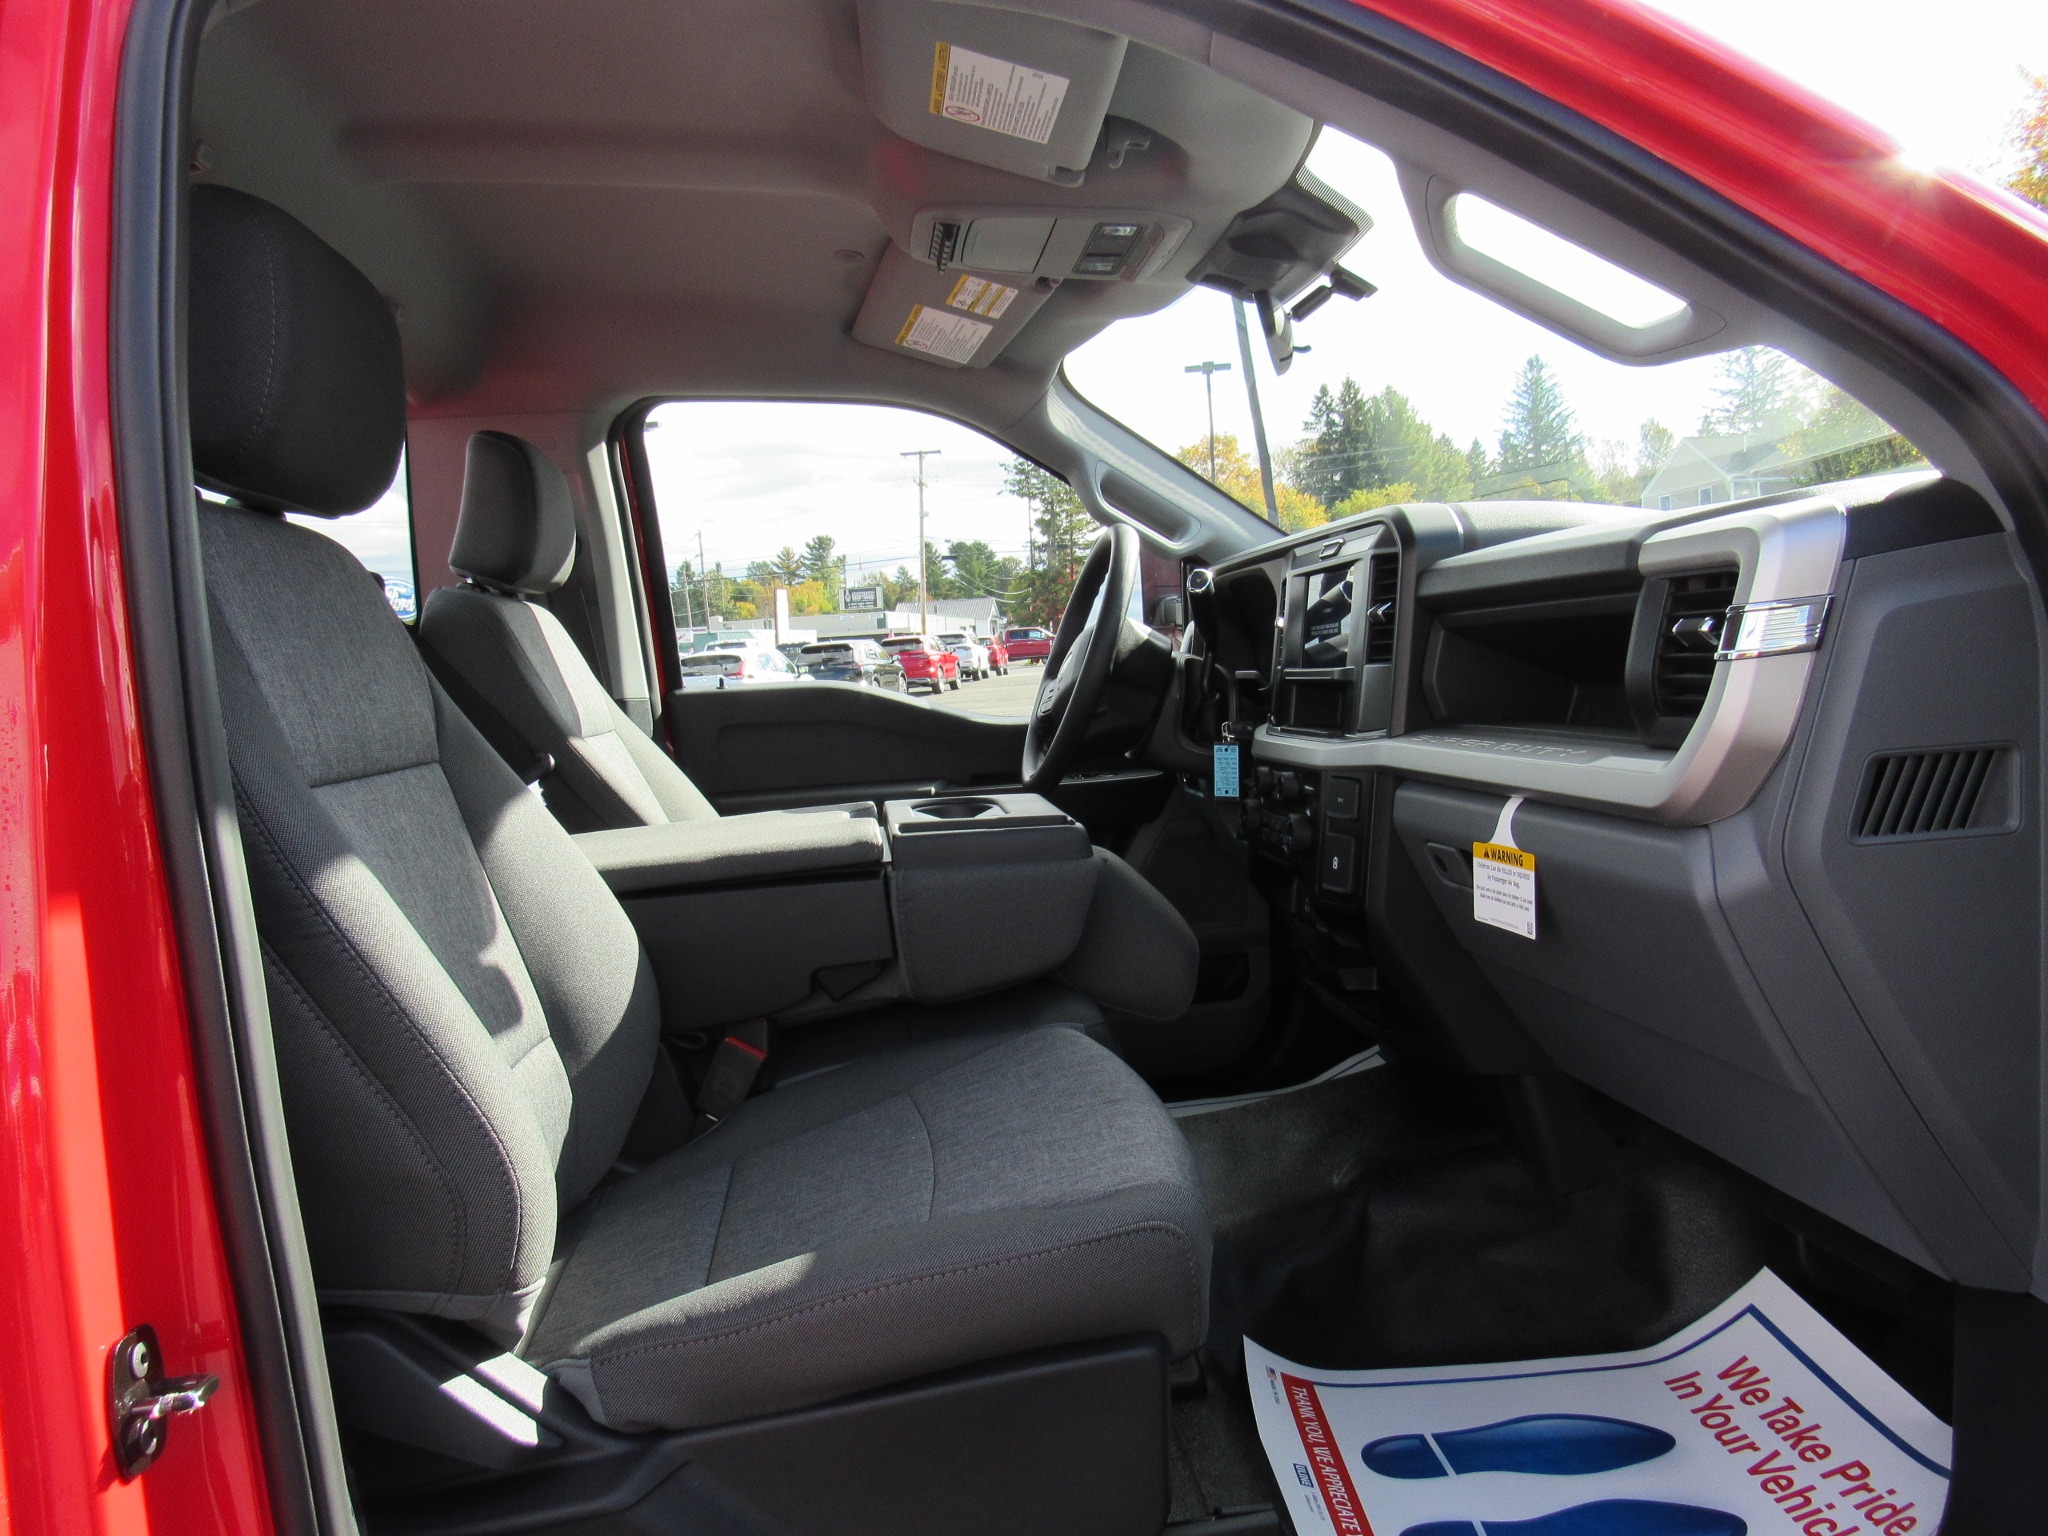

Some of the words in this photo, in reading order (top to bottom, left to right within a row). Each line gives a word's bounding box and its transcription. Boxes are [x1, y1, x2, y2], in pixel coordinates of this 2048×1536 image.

[385, 585, 416, 612] Ford
[1410, 734, 1496, 748] SUPER
[1493, 742, 1587, 757] DUTY
[1490, 847, 1524, 867] WARNING
[1291, 1385, 1318, 1421] THANK
[1663, 1370, 1703, 1401] In
[1690, 1392, 1762, 1455] Your
[1303, 1421, 1326, 1443] YOU,
[1312, 1446, 1335, 1465] WE
[1716, 1355, 1772, 1406] We
[1758, 1396, 1832, 1464] Take
[1819, 1459, 1919, 1536] Pride
[1294, 1464, 1313, 1487] ULINE
[1318, 1463, 1362, 1533] APPRECIATE
